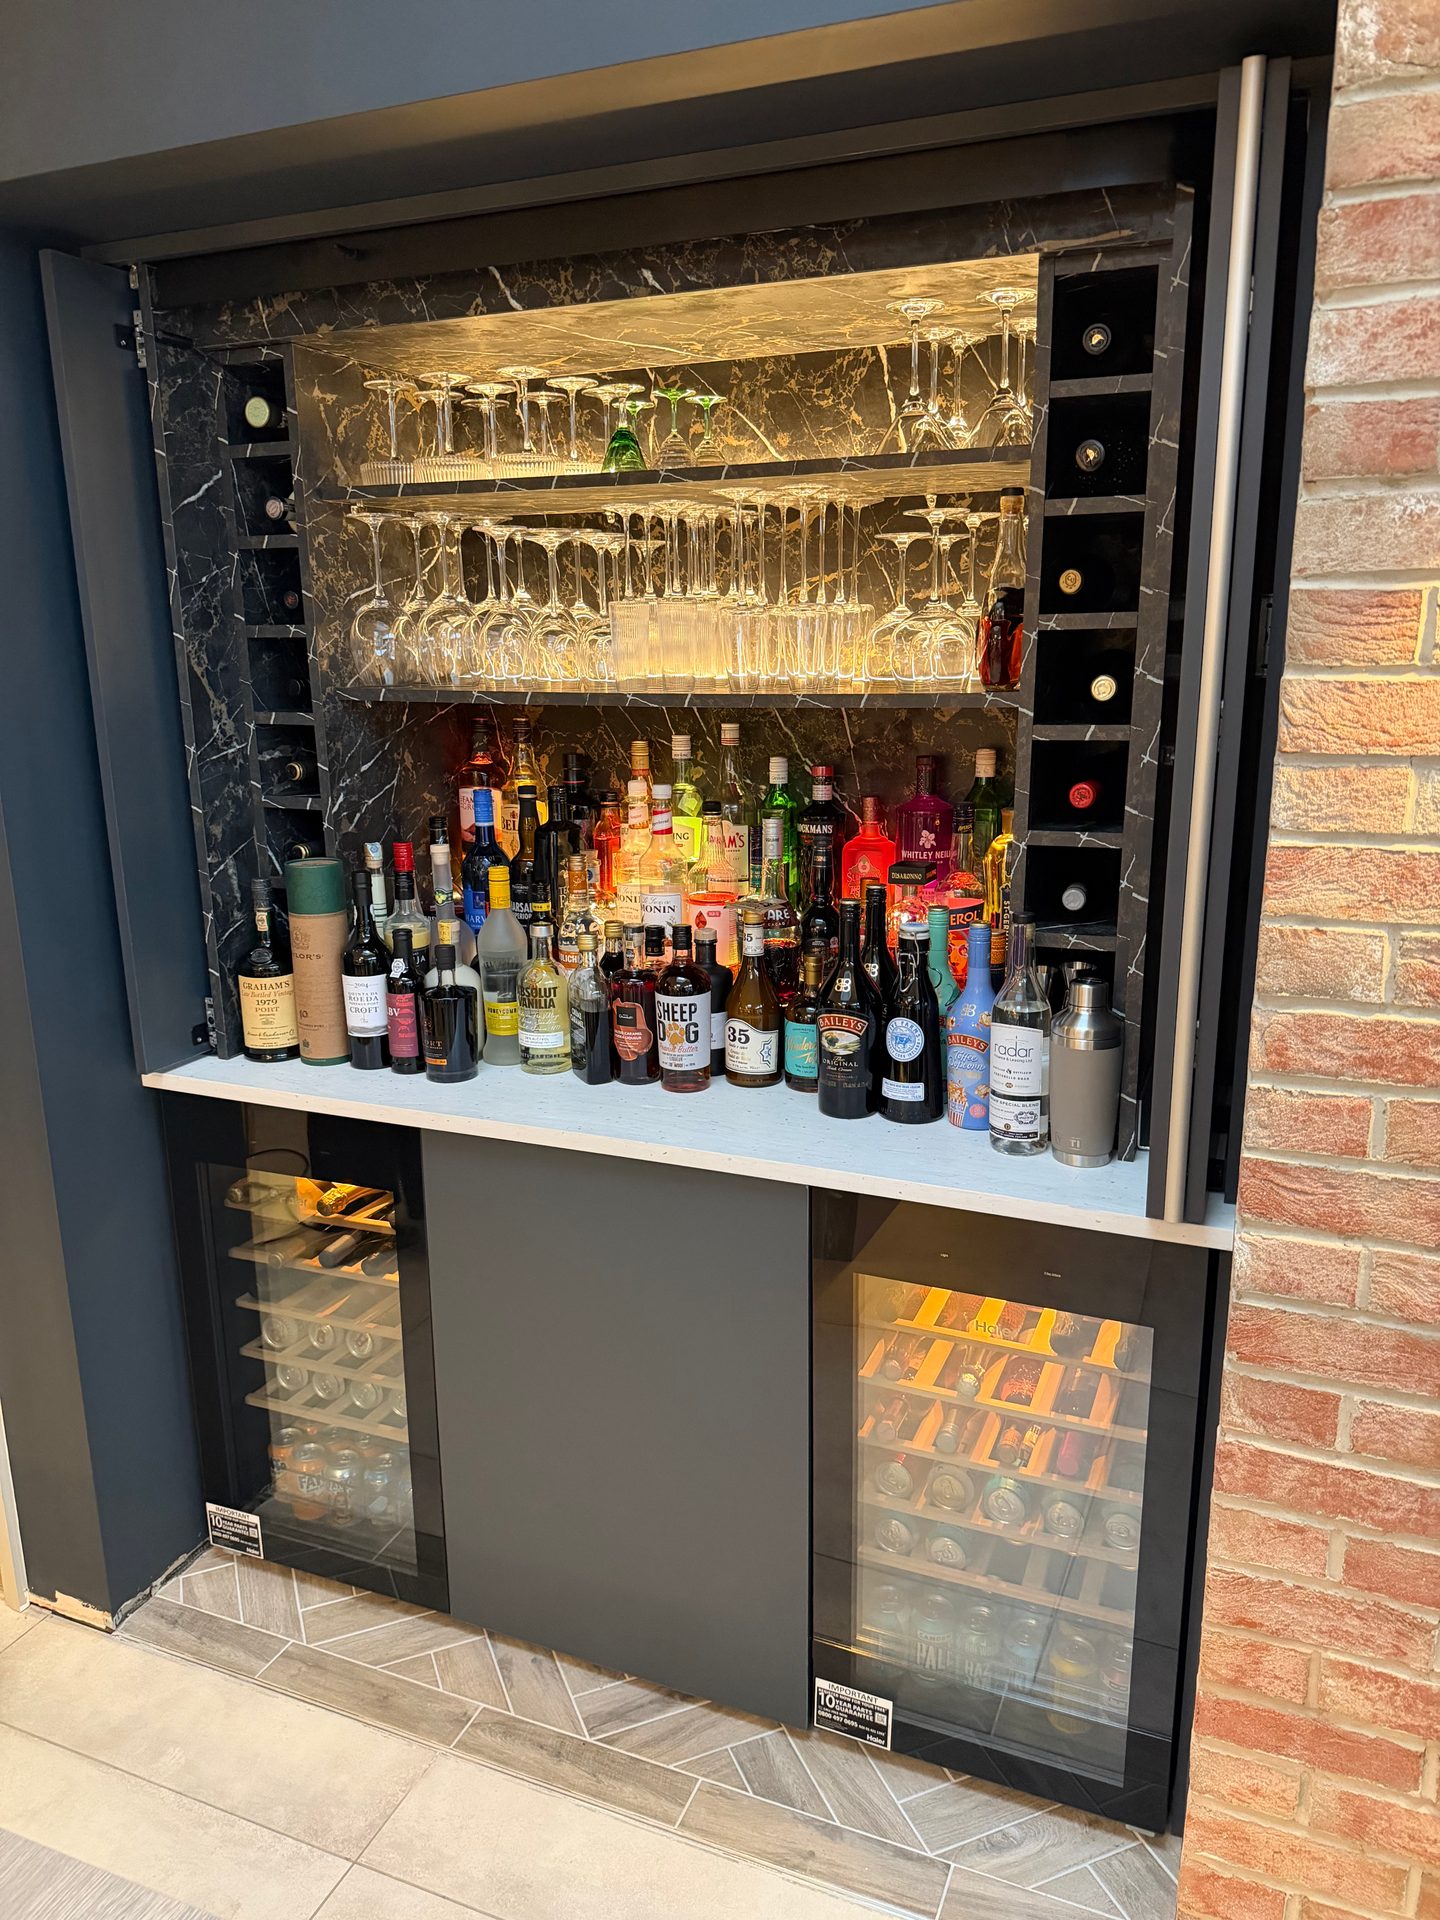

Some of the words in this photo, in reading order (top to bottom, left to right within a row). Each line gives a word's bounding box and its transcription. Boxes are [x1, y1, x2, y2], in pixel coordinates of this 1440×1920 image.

[798, 823, 834, 835] OCKMANS
[902, 850, 933, 860] WHITLEY
[891, 872, 922, 880] DISARONNO
[511, 901, 533, 913] ARSAL
[949, 910, 979, 927] EROL
[242, 980, 290, 991] GRAHAM'S
[255, 998, 278, 1006] 1979
[348, 995, 379, 1003] ROEDA
[349, 1006, 379, 1014] CROFT
[656, 999, 698, 1022] SHEEP
[819, 1016, 864, 1031] BAILEYS
[727, 1026, 750, 1044] 35
[677, 1045, 699, 1053] Butter
[947, 1036, 987, 1052] BAILEYS
[994, 1040, 1034, 1058] radar
[954, 1049, 978, 1063] Toffee
[822, 1059, 859, 1068] ORIGINAL
[215, 1506, 250, 1521] IMPORTANT
[210, 1514, 223, 1528] 10
[828, 1683, 879, 1704] IMPORTANT
[818, 1692, 836, 1709] 10
[835, 1699, 852, 1709] YEAR
[852, 1704, 873, 1716] PARTS
[835, 1705, 874, 1722] GUARANTEE
[866, 1733, 886, 1746] Haier
